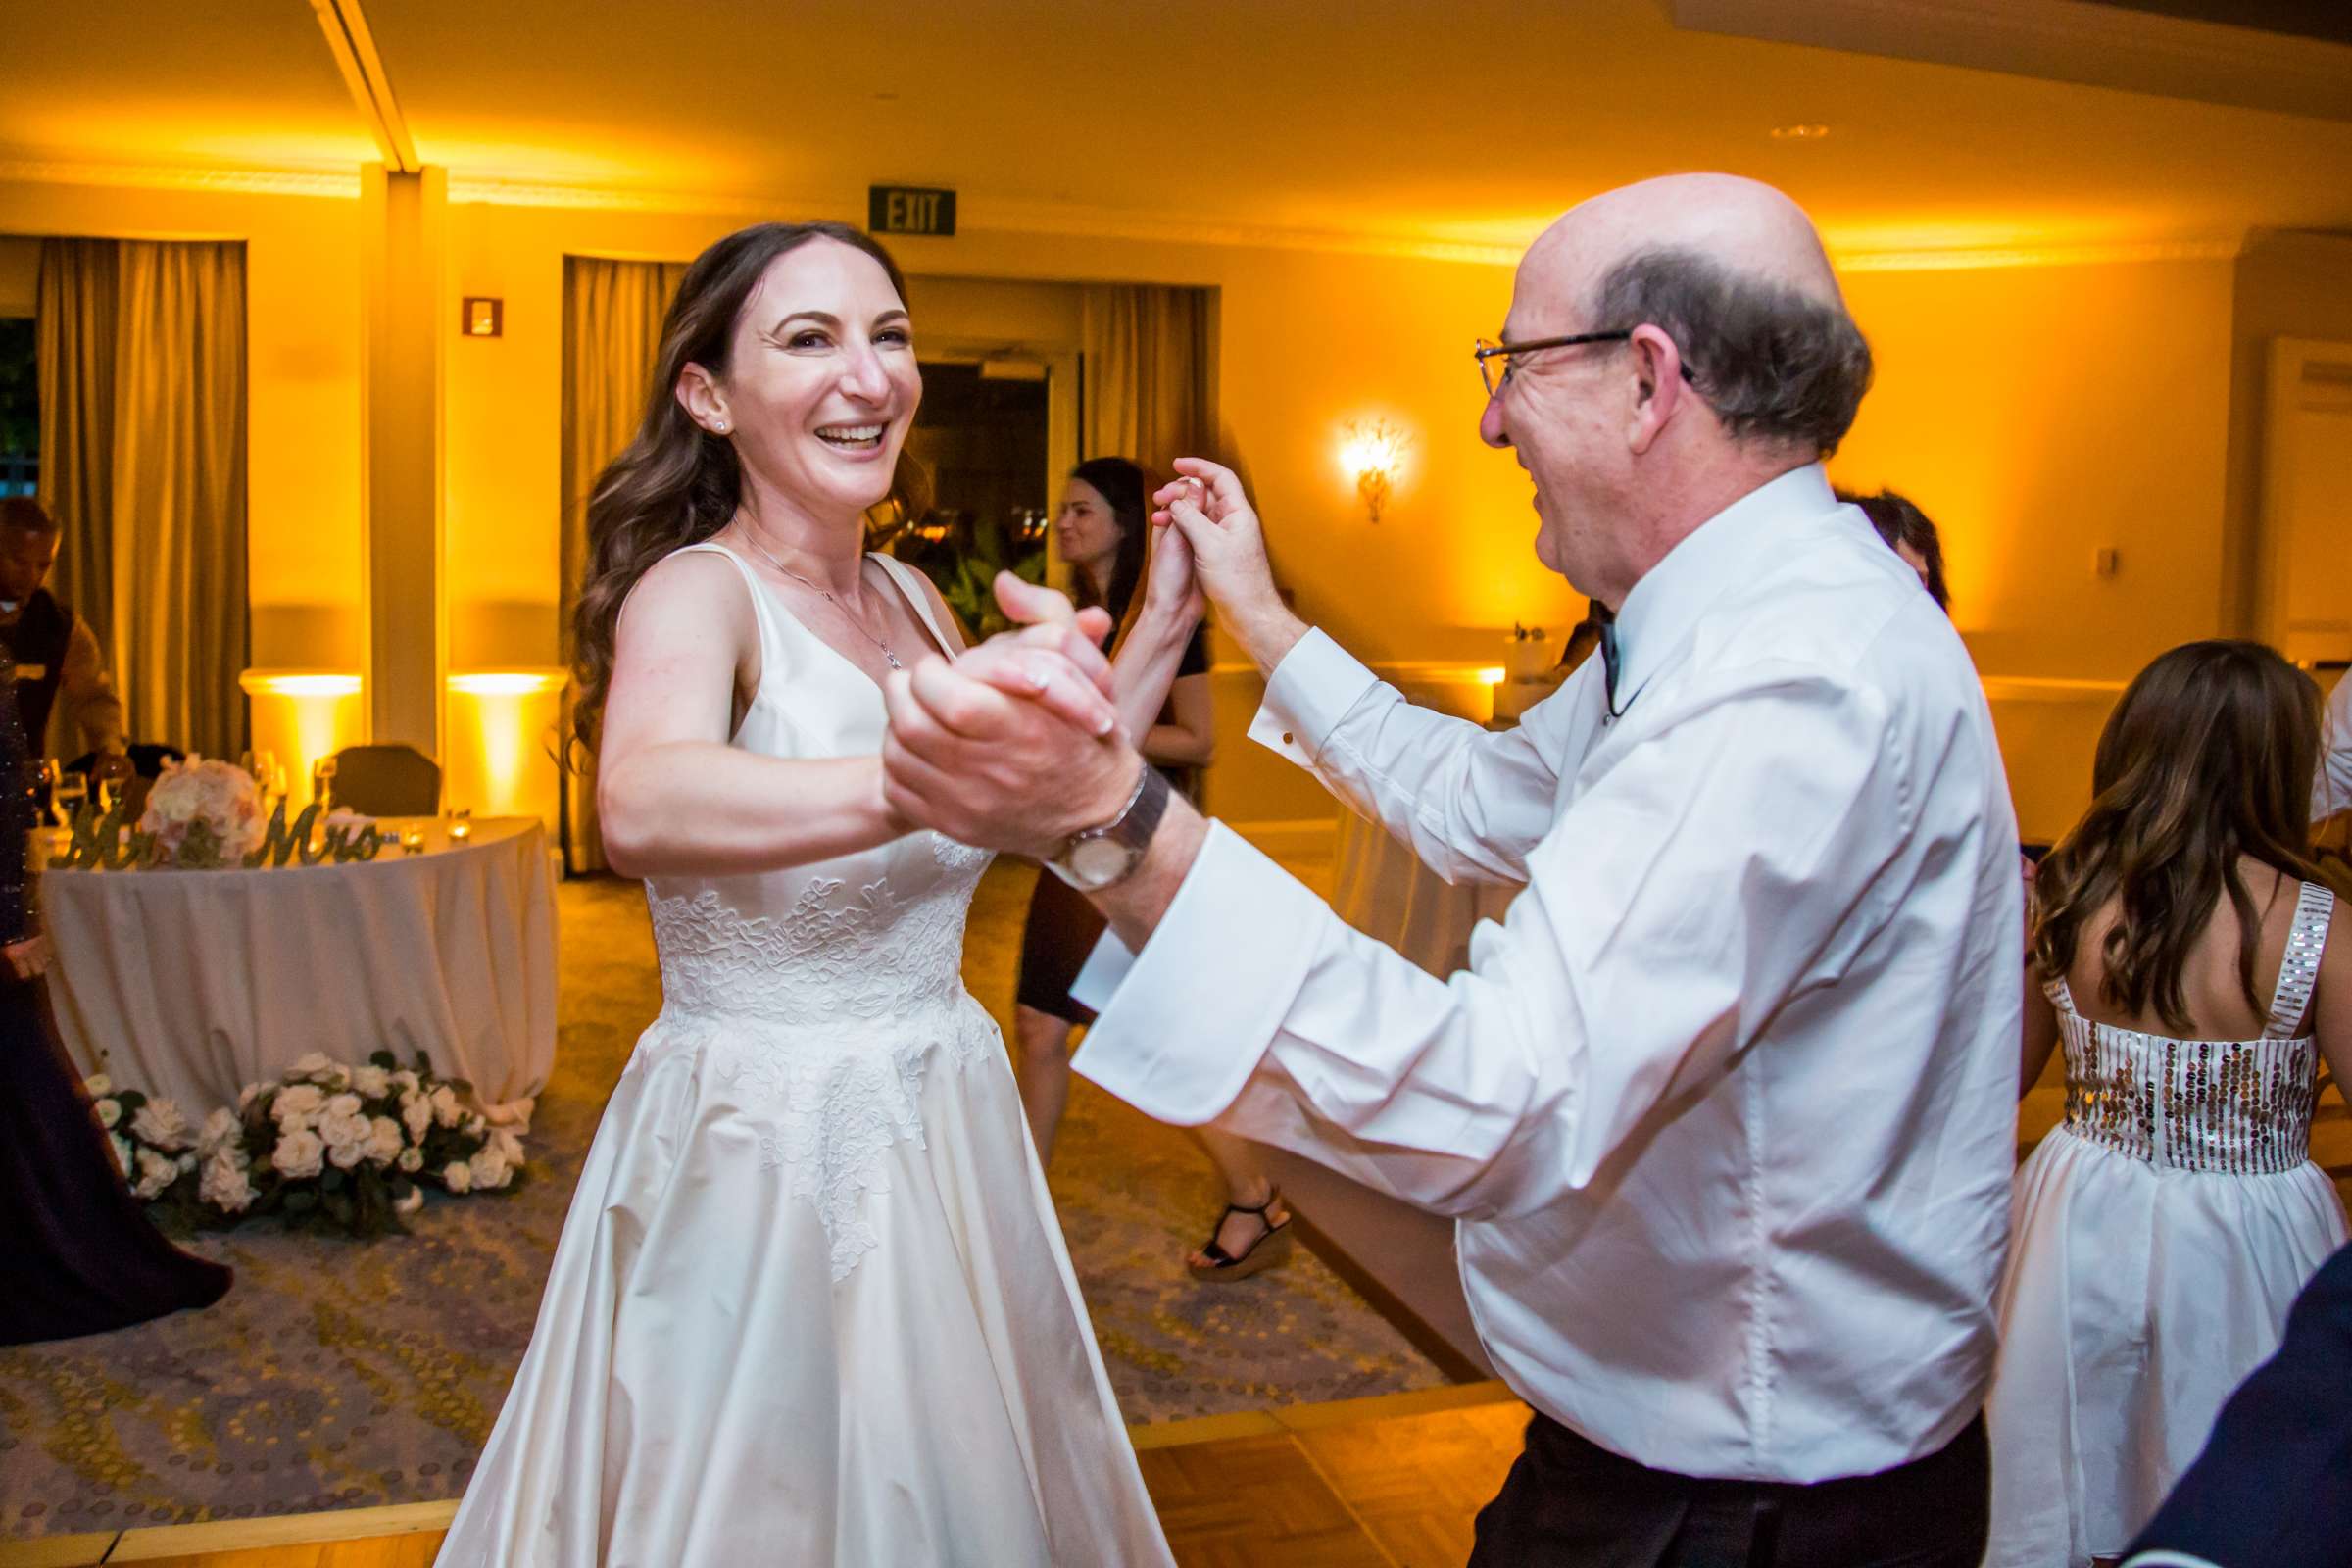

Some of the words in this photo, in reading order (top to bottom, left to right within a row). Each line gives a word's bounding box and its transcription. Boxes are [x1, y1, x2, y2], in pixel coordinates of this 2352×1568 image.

[886, 192, 940, 232] EXIT
[48, 802, 159, 871] Mr
[241, 796, 383, 868] Mrs
